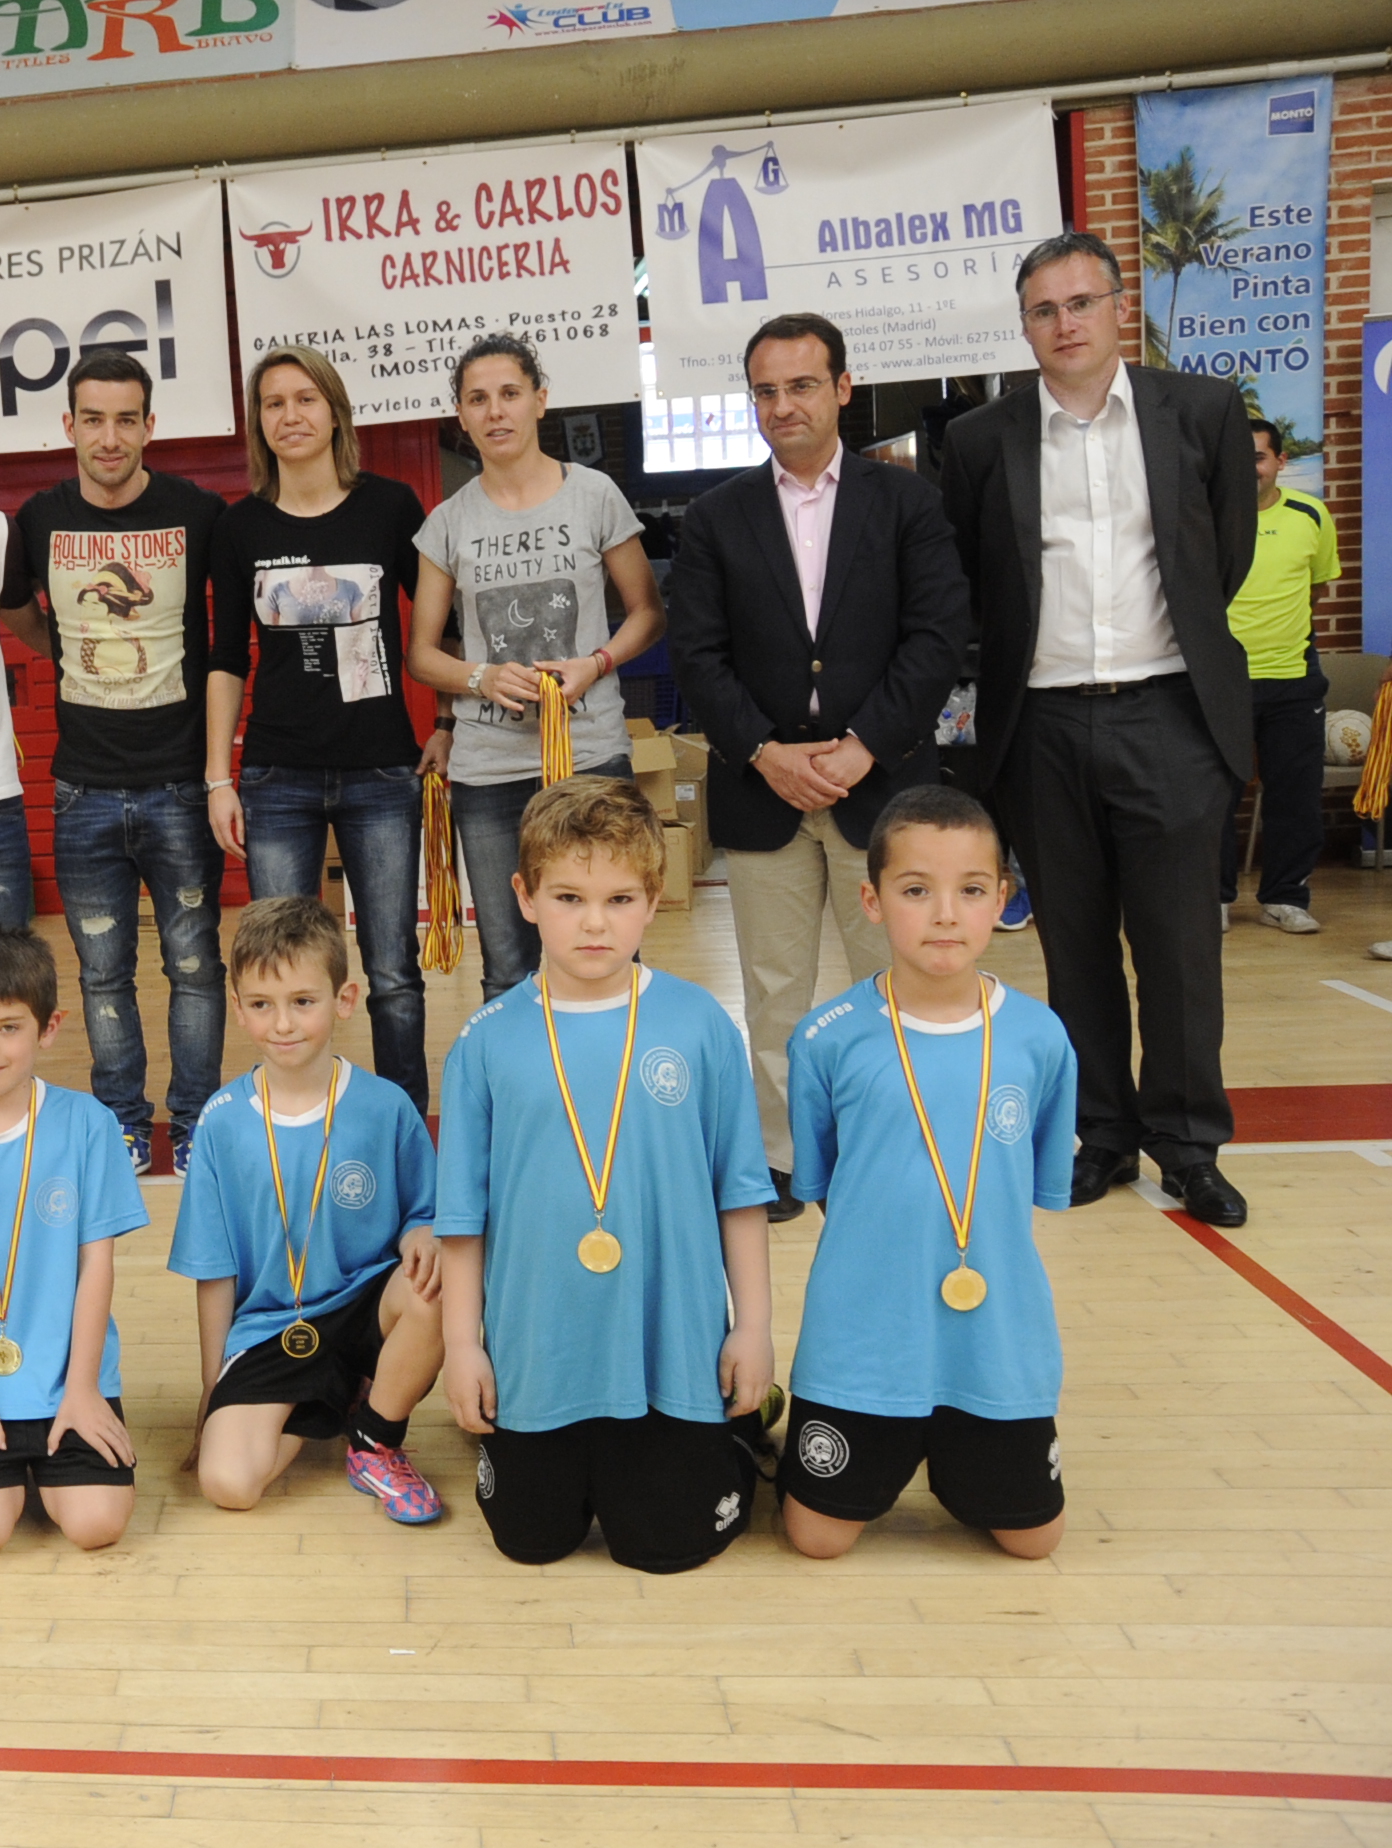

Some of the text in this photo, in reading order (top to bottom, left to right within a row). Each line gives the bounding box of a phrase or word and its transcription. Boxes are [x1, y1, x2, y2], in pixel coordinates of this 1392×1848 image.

[553, 6, 651, 29] CLUB
[196, 32, 273, 49] BRAVO
[762, 156, 782, 187] G
[321, 168, 623, 242] IRRA & CARLOS
[657, 201, 685, 233] M
[1249, 203, 1313, 229] Este
[698, 177, 769, 305] A
[818, 198, 1023, 254] Albalex MG
[58, 229, 183, 274] PRIZÁN
[381, 237, 571, 290] CARNICERIA
[1201, 242, 1313, 267] Verano
[827, 252, 1024, 288] ASESORÍA
[1233, 275, 1311, 299] Pinta
[855, 303, 906, 321] Hidalgo,
[909, 302, 923, 314] 11
[1178, 312, 1311, 339] Bien con
[254, 329, 346, 351] GALERIA
[355, 323, 395, 341] LAS
[404, 316, 486, 335] LOMAS
[508, 310, 582, 327] Puesto
[591, 303, 619, 320] 28
[883, 318, 937, 336] (Madrid)
[368, 343, 394, 359] 38
[426, 337, 463, 353] Tlf.
[680, 356, 716, 369] Tfno.:
[718, 354, 733, 366] 91
[853, 341, 876, 355] 614
[879, 340, 894, 352] 07
[898, 338, 913, 350] 55
[925, 334, 963, 349] Móvil:
[967, 332, 989, 345] 627
[994, 329, 1016, 342] 511
[881, 350, 996, 370] www.albalexmg.es
[1179, 337, 1310, 377] MONTÓ
[351, 397, 422, 417] ervicio
[430, 394, 442, 408] a
[54, 529, 185, 561] ROLLING STONES
[471, 524, 571, 559] THERE'S
[474, 553, 577, 583] BEAUTY IN
[470, 1001, 504, 1025] errea
[815, 1001, 854, 1029] errea
